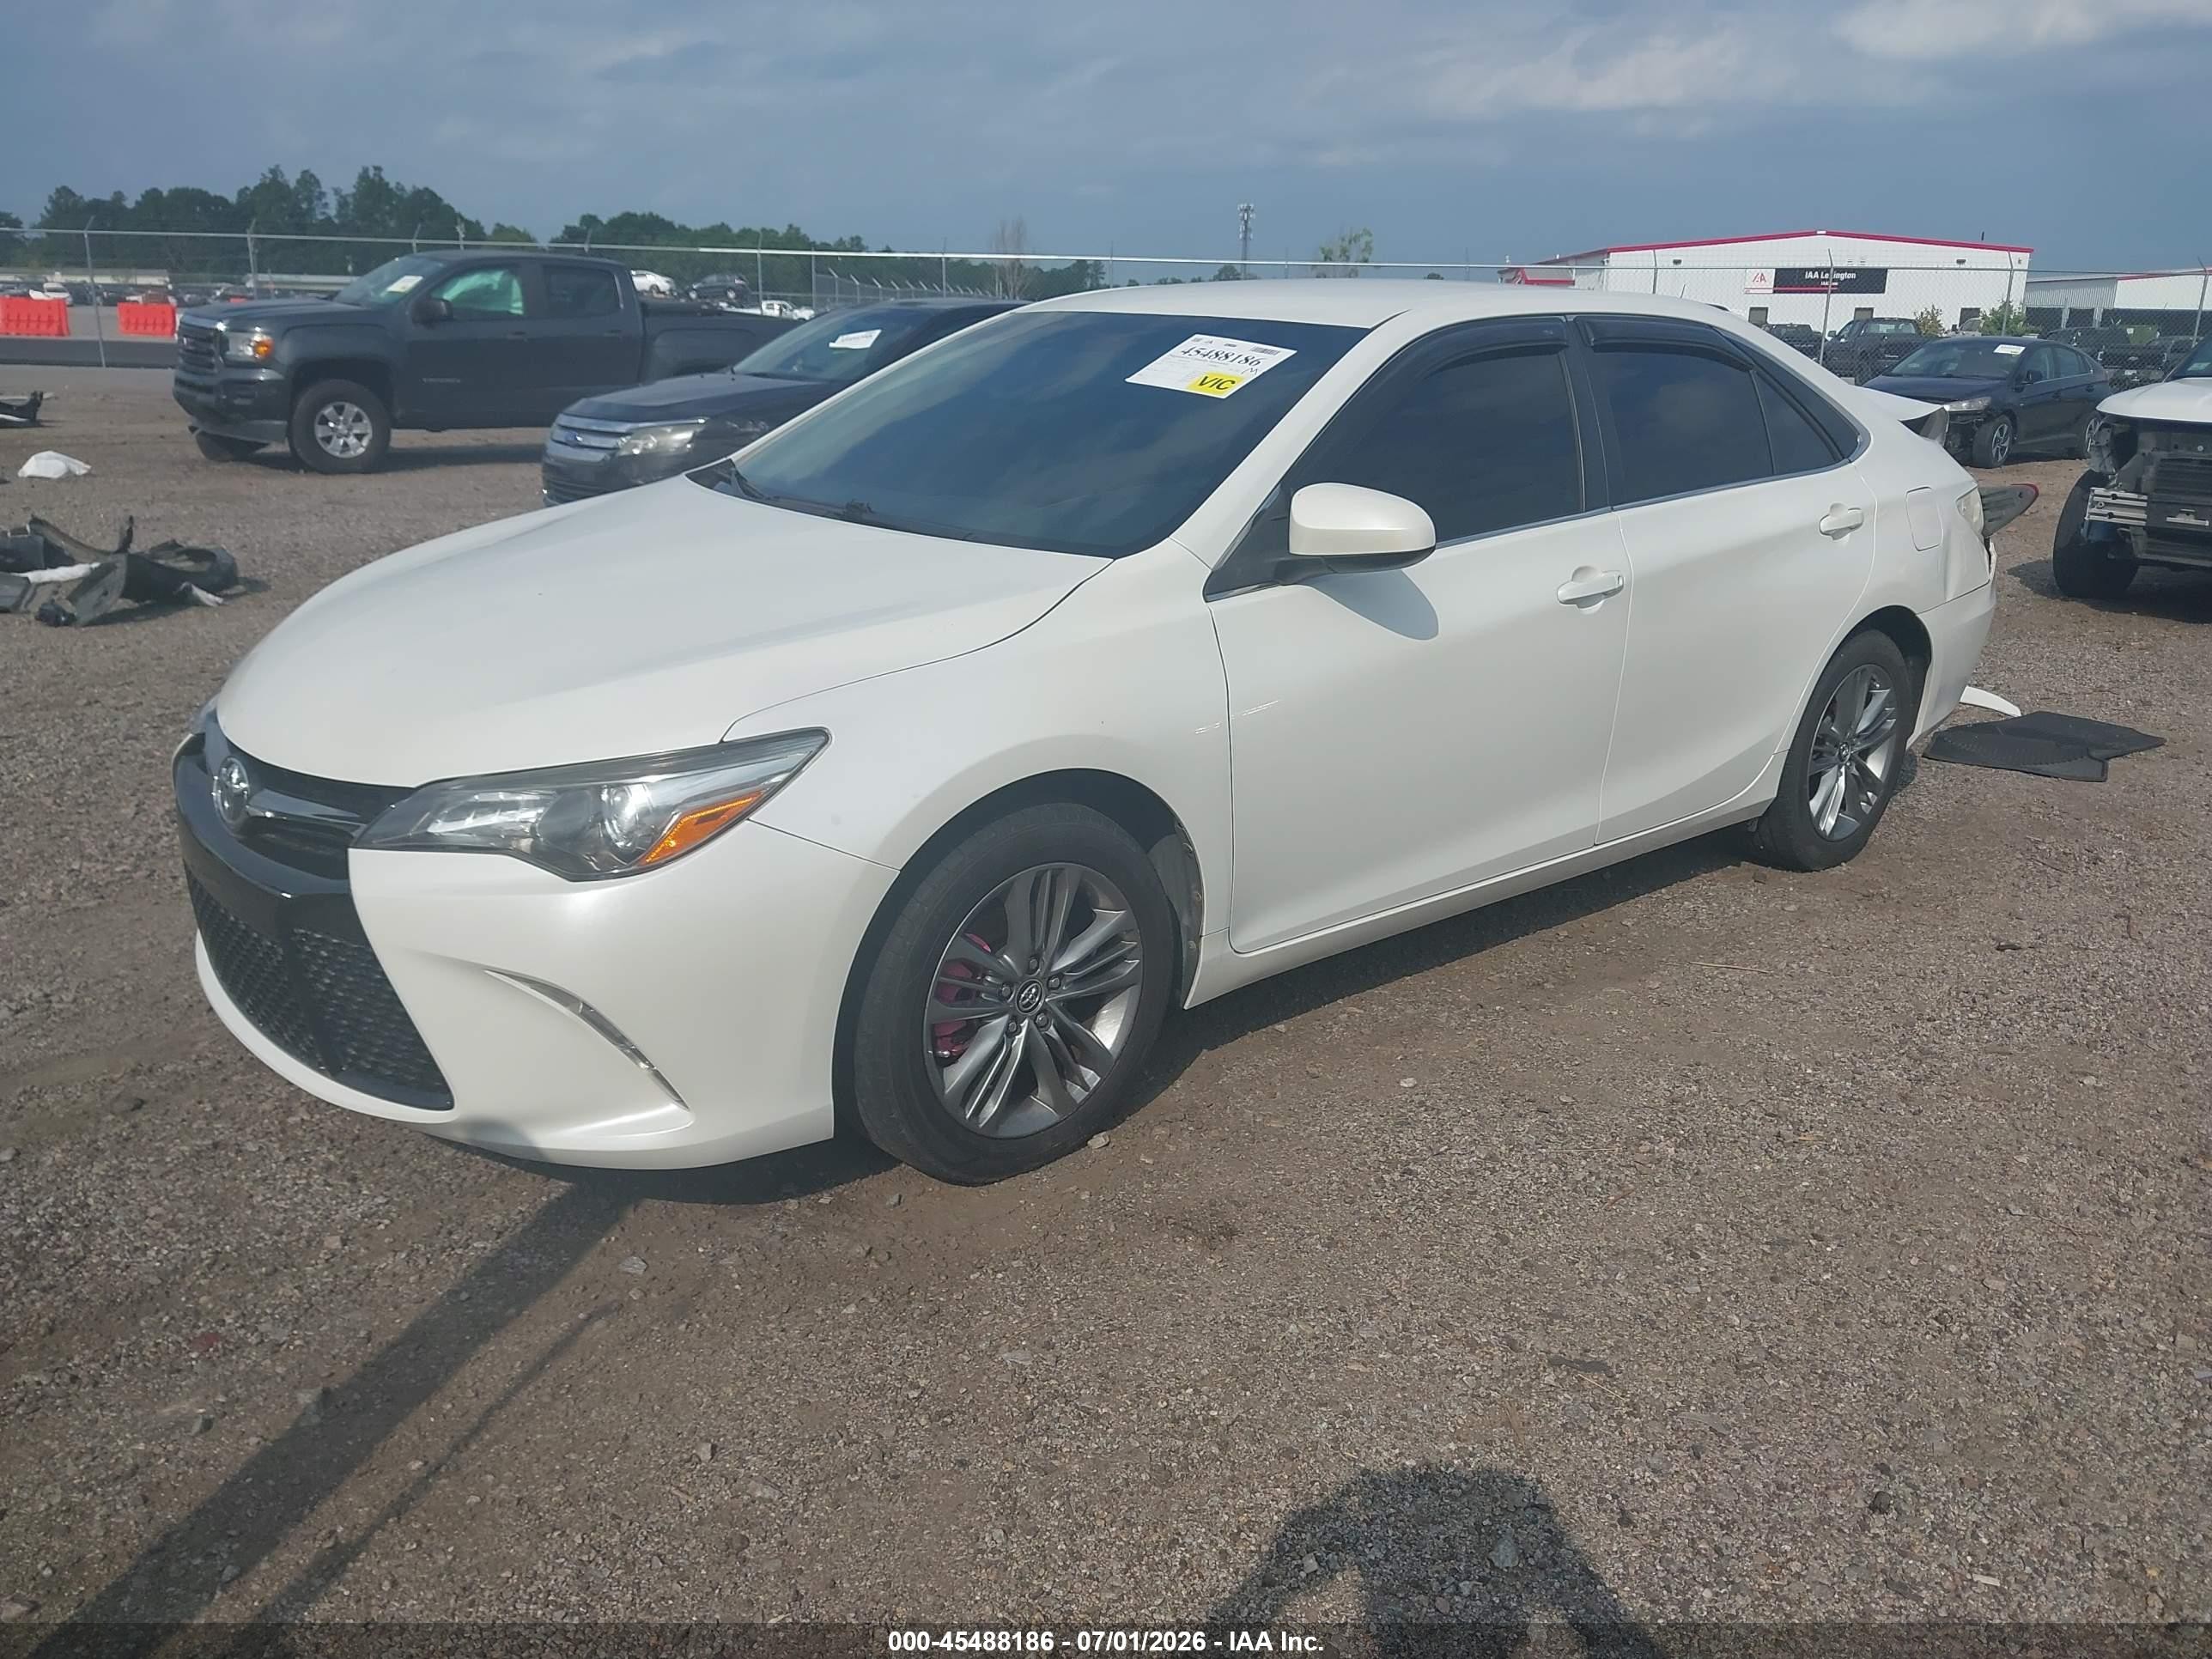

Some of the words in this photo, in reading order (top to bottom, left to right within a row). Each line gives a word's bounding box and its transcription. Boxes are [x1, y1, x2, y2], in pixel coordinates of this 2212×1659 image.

[1805, 270, 1820, 279] IAA
[1820, 270, 1856, 281] Leington
[1181, 345, 1266, 368] 45488186
[1198, 376, 1236, 391] VIC
